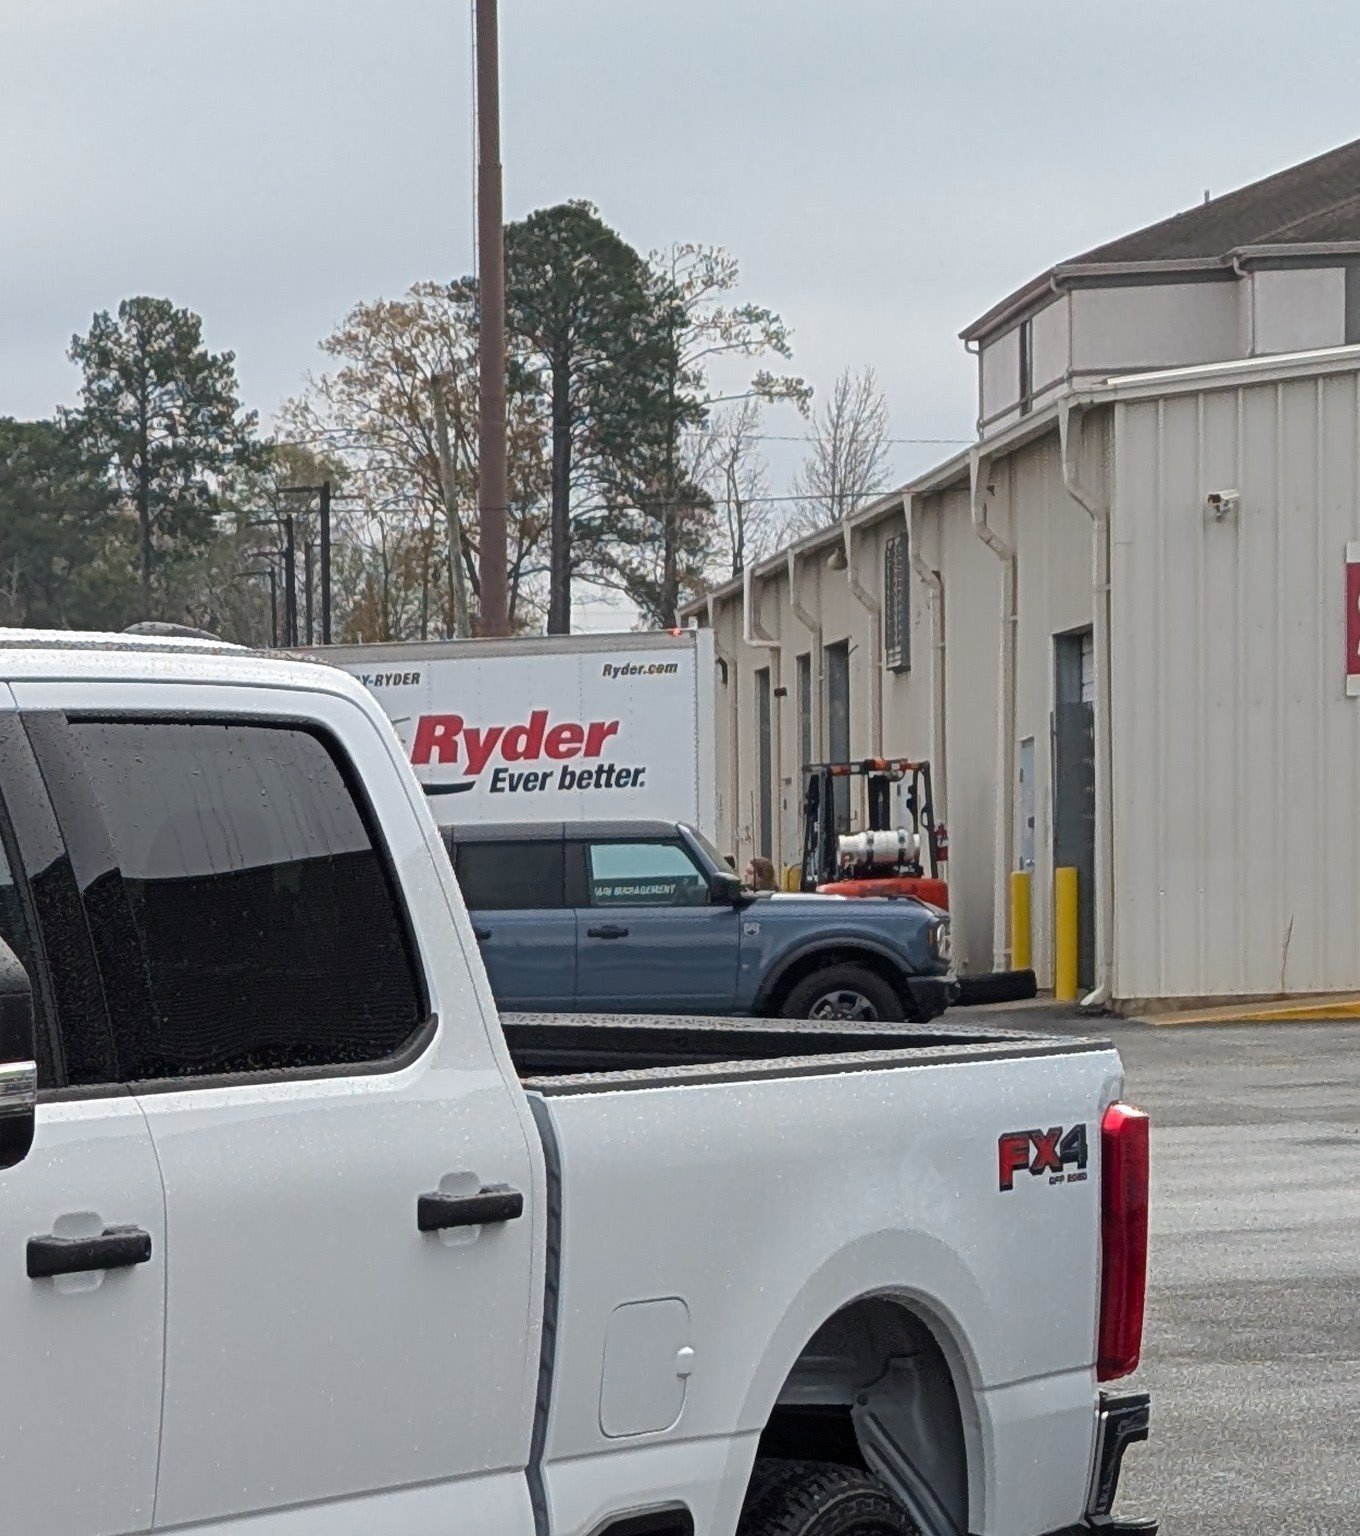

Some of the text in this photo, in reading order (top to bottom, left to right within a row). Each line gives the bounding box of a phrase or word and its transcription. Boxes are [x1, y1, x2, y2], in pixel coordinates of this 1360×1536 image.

[410, 710, 620, 776] Ryder
[489, 763, 647, 793] Ever better.
[998, 1123, 1088, 1192] FX4
